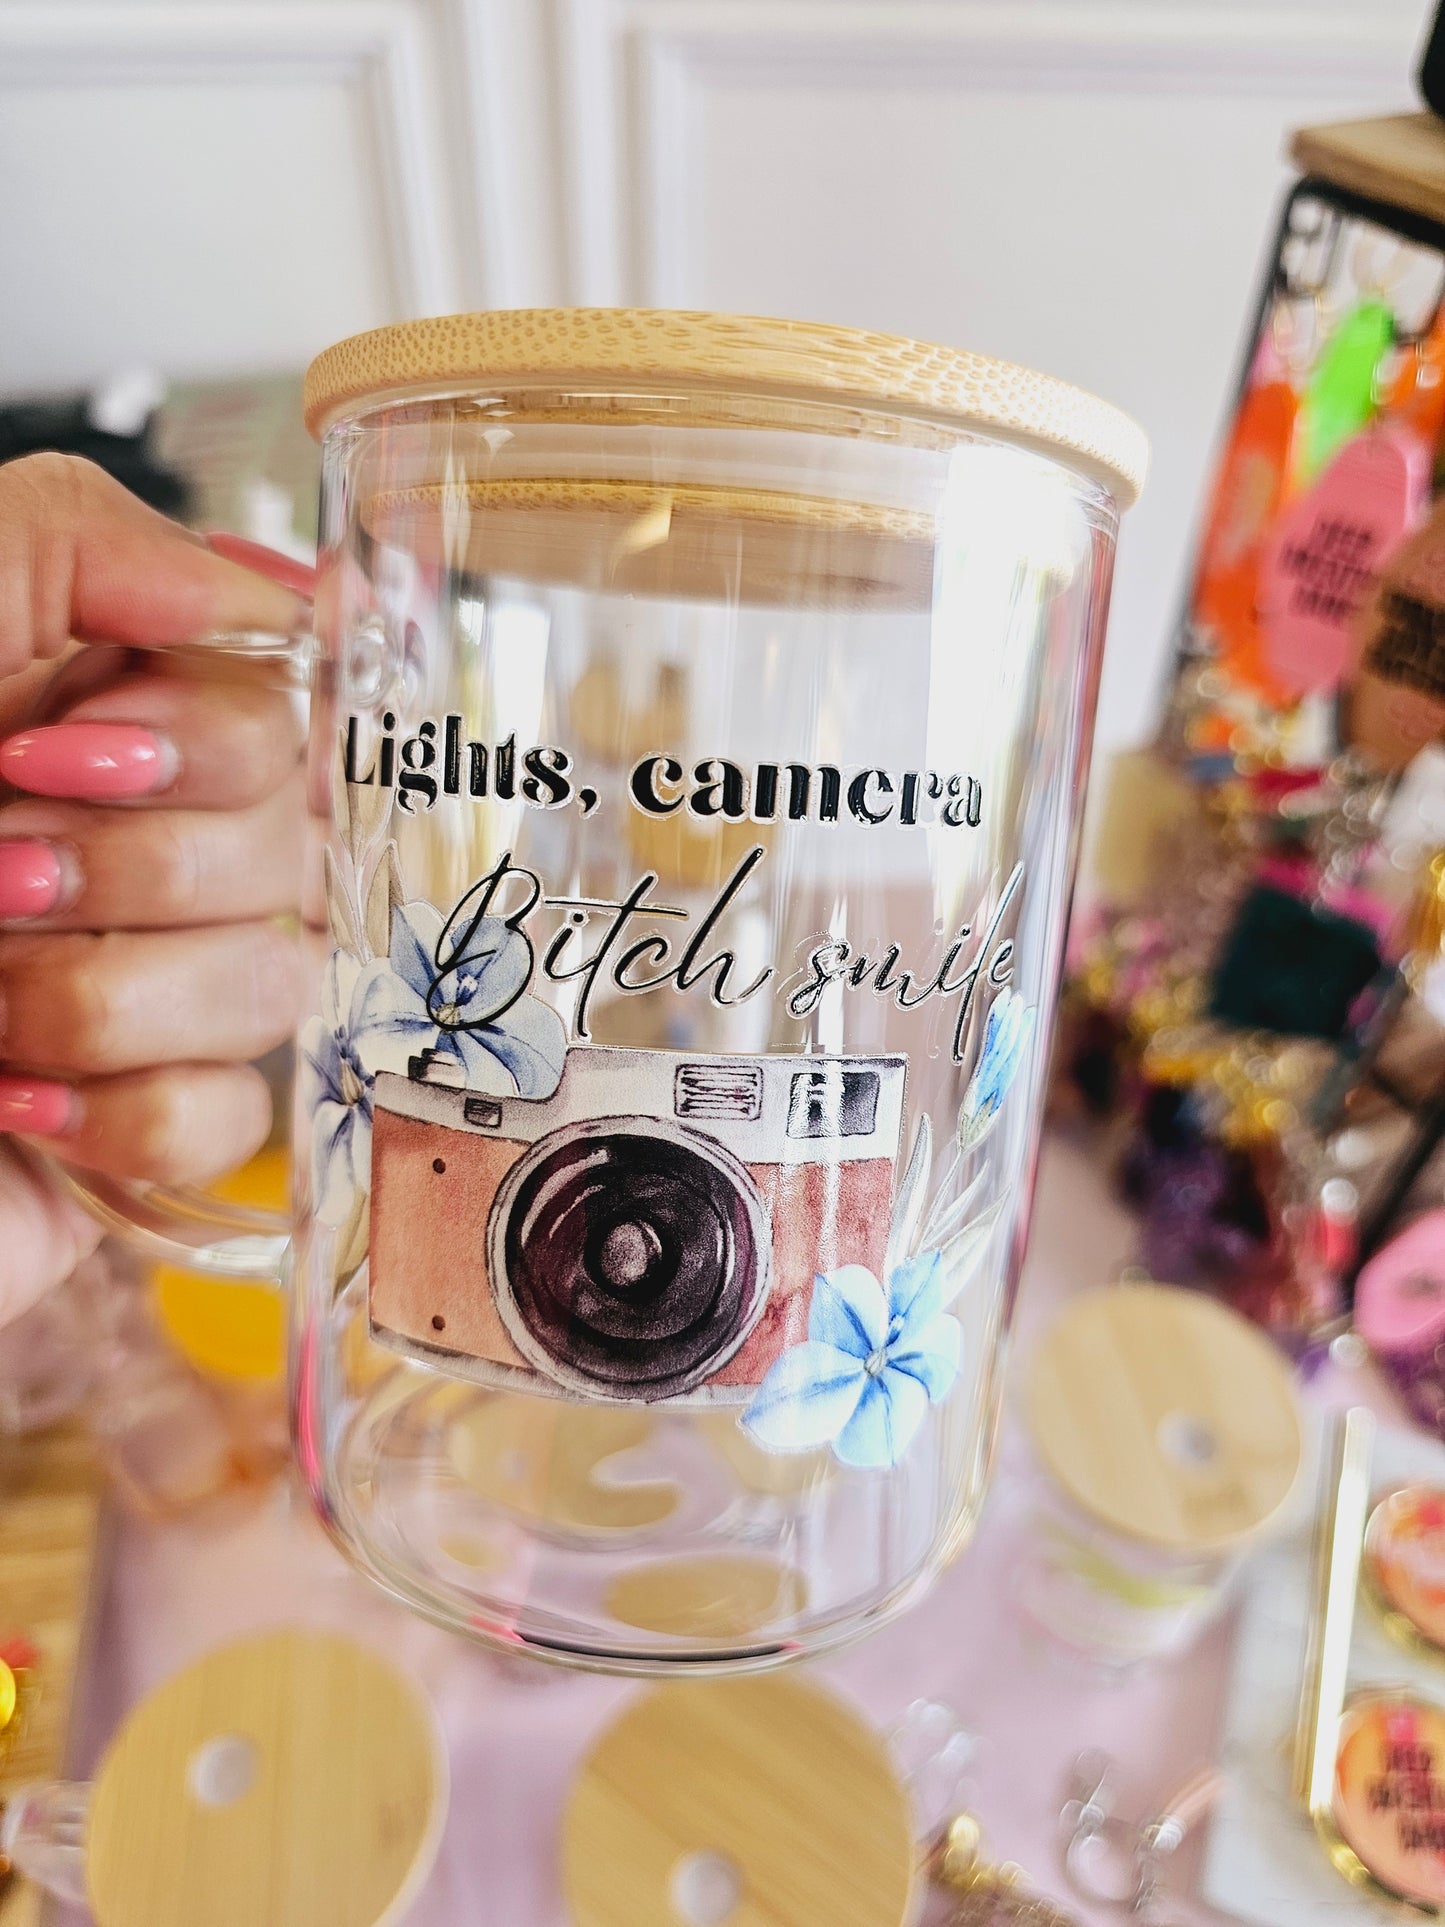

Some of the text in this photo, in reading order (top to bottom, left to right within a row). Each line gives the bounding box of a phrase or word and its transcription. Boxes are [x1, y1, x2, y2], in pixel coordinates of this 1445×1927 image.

[345, 712, 982, 828] Lights, camera
[427, 847, 1021, 1062] Bitch smile
